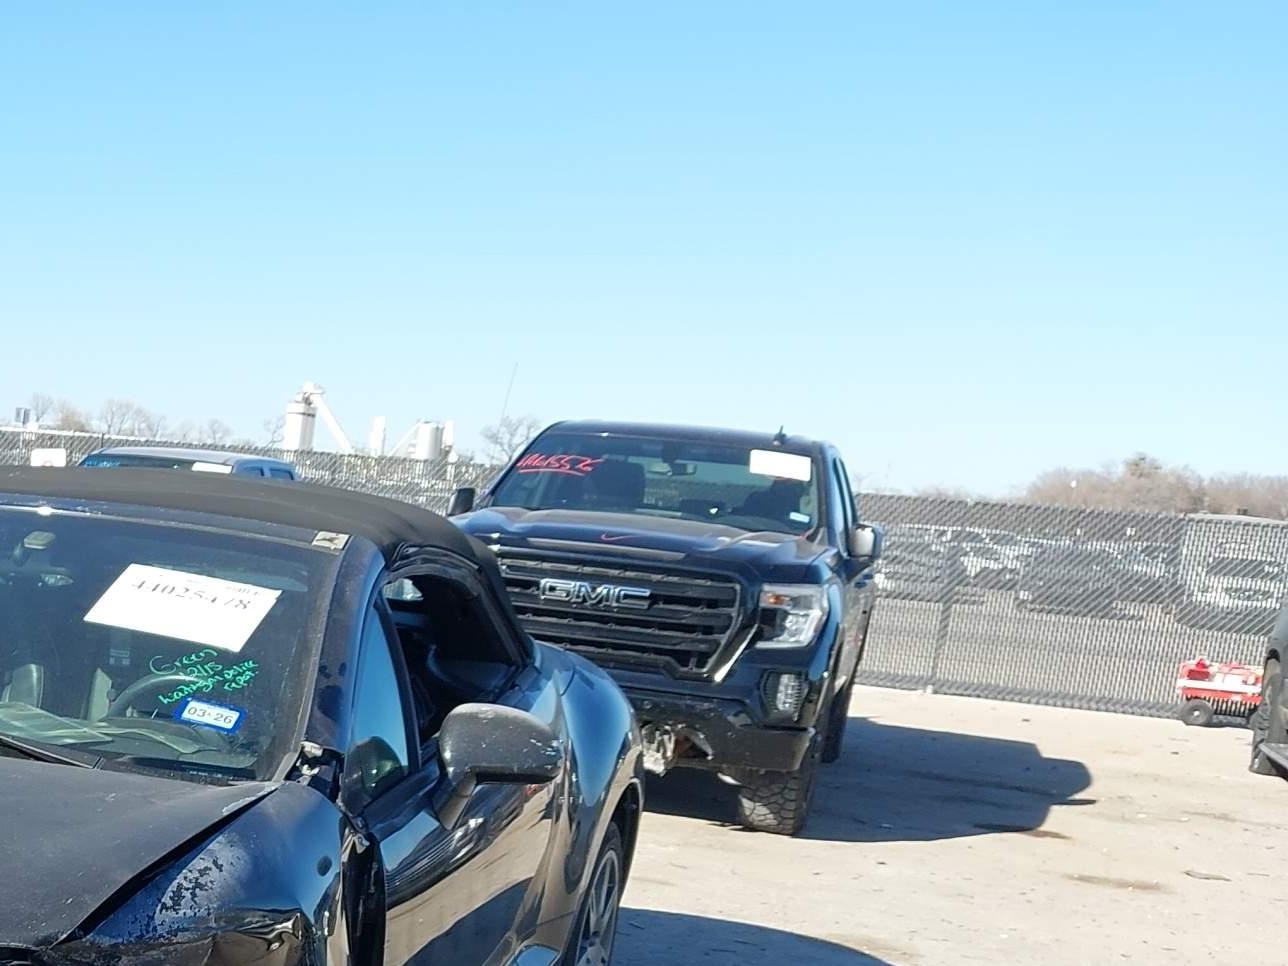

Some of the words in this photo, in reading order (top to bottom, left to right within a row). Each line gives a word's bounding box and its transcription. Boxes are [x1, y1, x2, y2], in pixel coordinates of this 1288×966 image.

[540, 578, 651, 609] GMC
[187, 706, 207, 718] 03
[213, 712, 233, 725] 26
